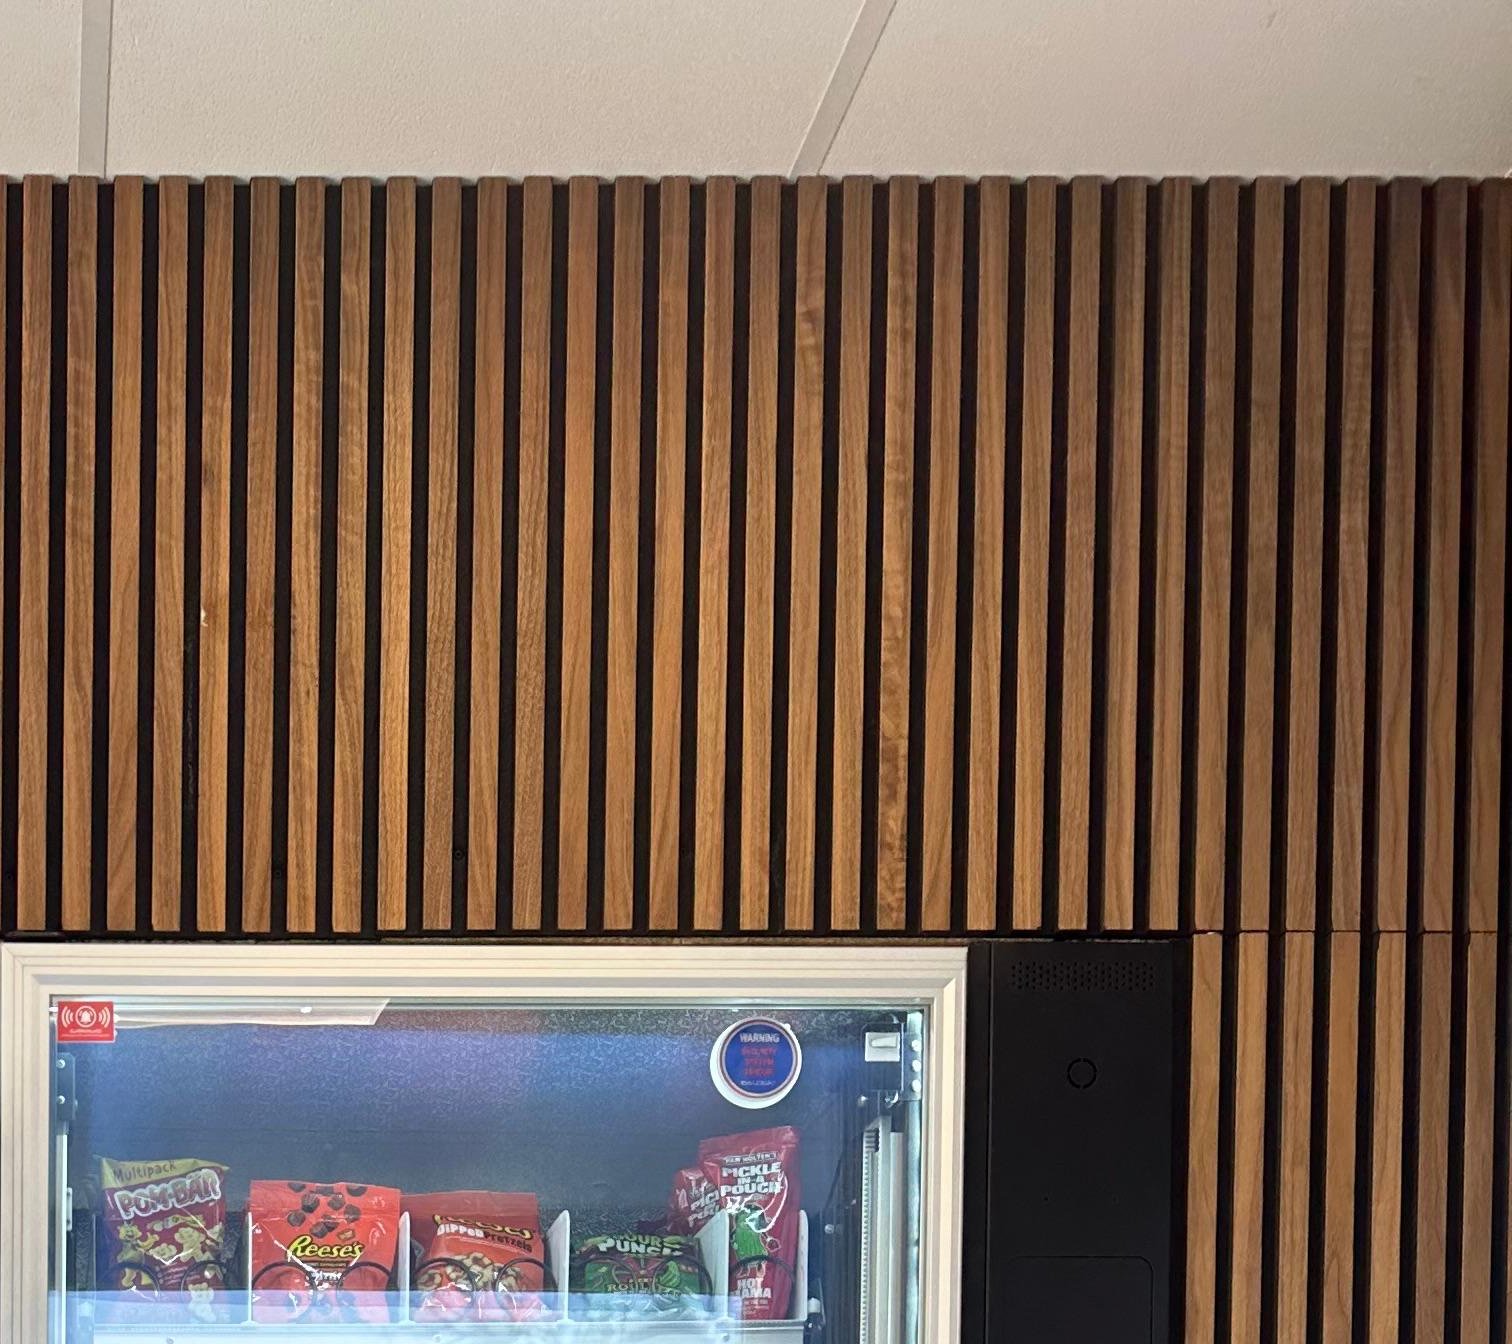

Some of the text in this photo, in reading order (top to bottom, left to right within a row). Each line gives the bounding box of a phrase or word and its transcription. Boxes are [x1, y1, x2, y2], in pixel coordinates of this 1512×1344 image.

[739, 1033, 780, 1043] WARNING
[113, 1160, 177, 1181] Multipack
[721, 1161, 782, 1178] PICKLE
[719, 1181, 782, 1197] POUCH
